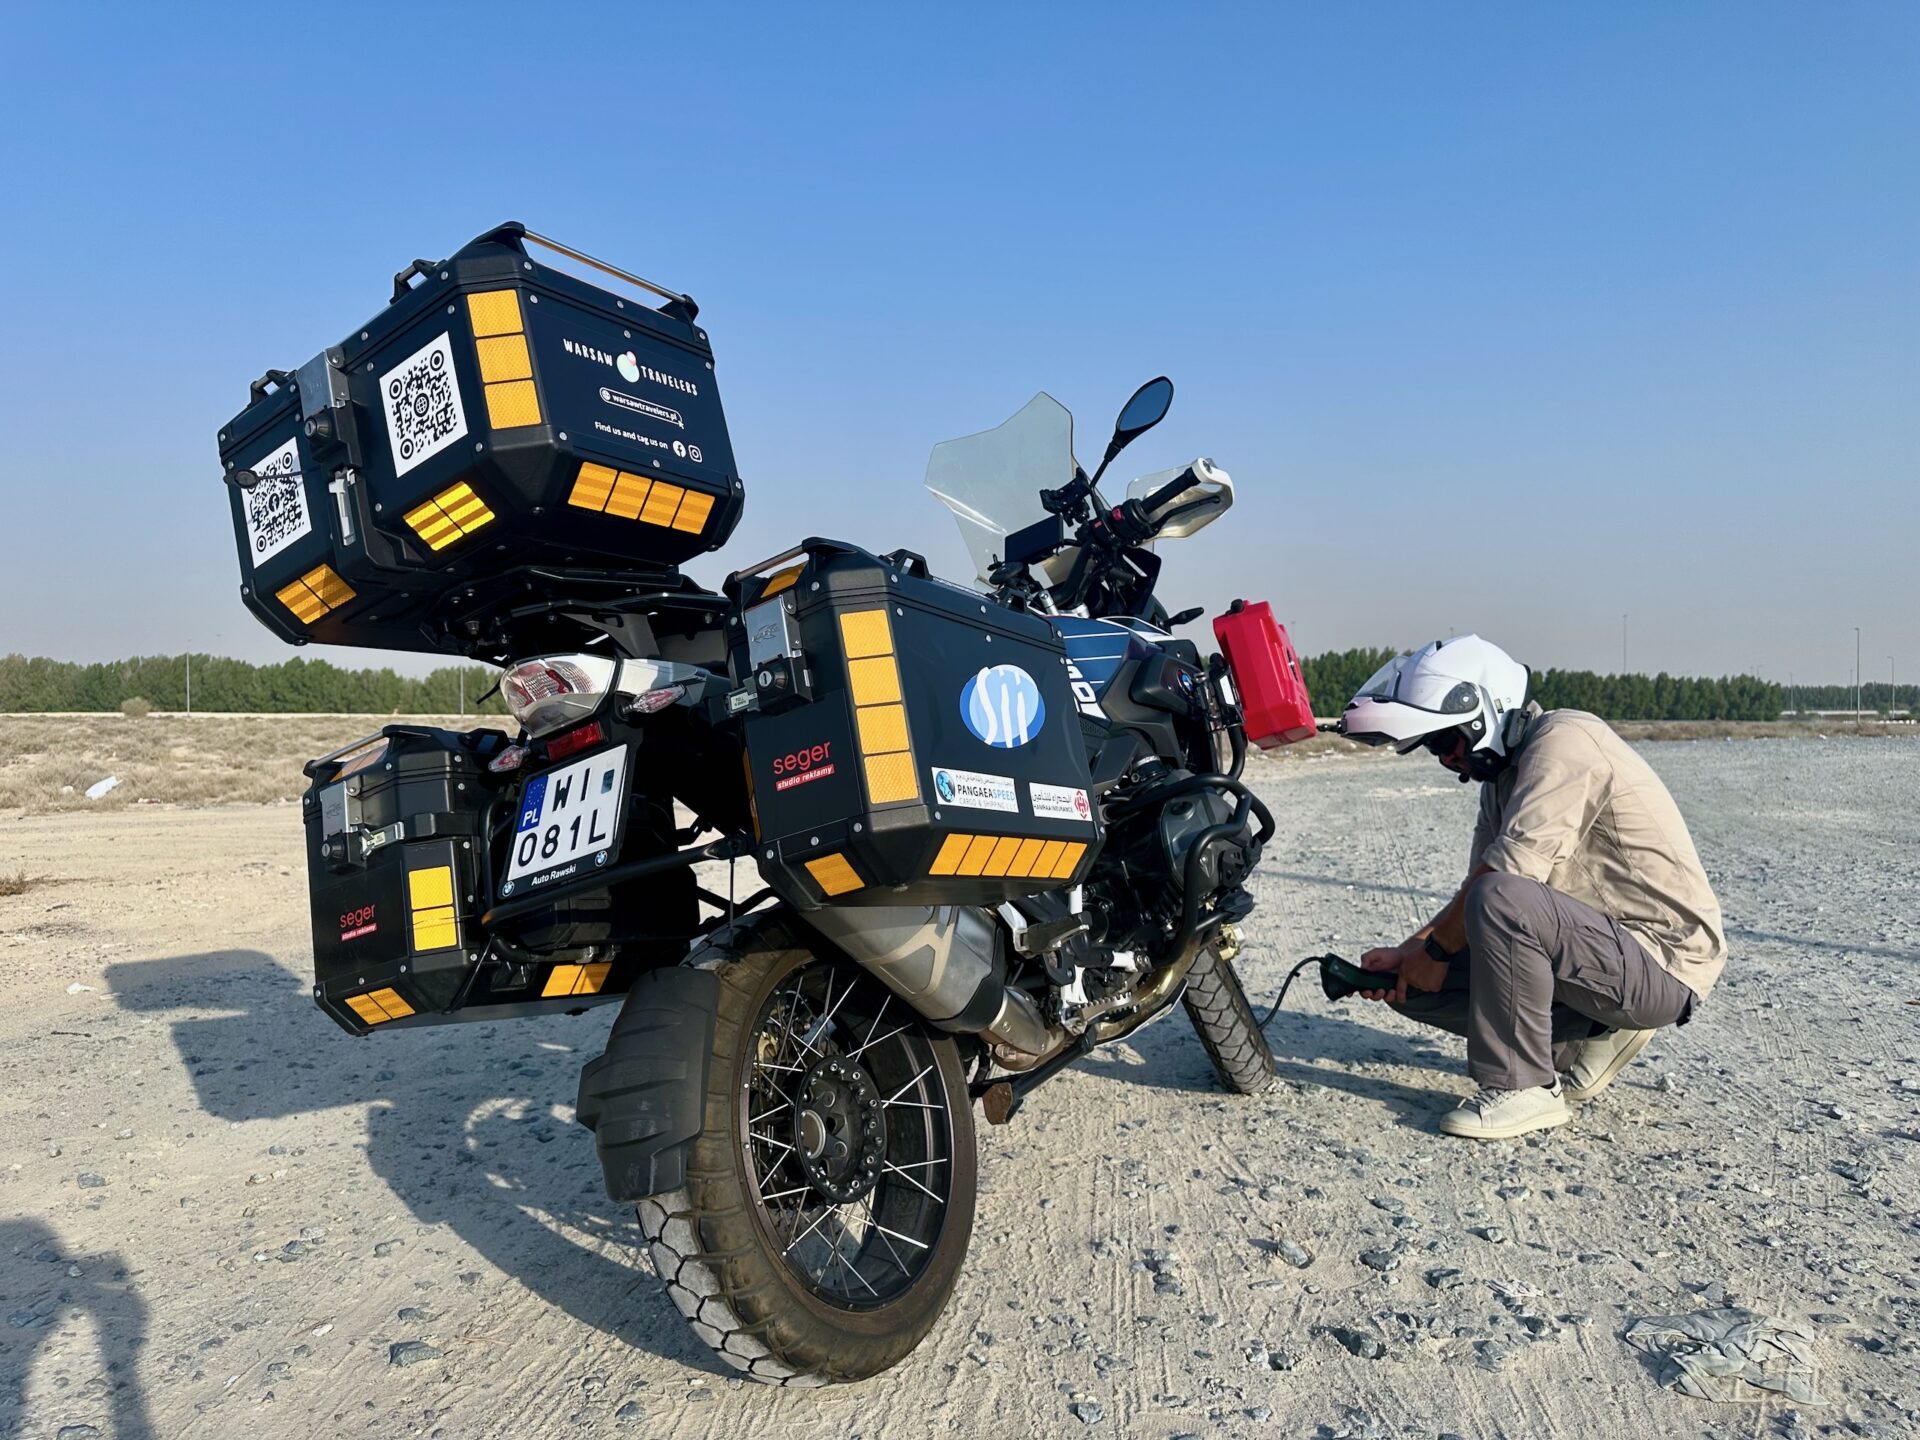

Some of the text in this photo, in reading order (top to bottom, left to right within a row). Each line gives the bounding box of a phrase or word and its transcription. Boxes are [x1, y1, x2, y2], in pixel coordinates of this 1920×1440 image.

[562, 338, 698, 396] WARSAW TRAVELERS
[612, 394, 678, 421] warsawtravelers.pl
[594, 421, 669, 450] Find us and tag us on
[772, 741, 831, 775] seger
[552, 767, 591, 812] WI
[777, 766, 833, 789] studio reklamy
[522, 808, 539, 828] PL
[518, 808, 606, 867] 081L
[531, 863, 577, 886] Auto Rawski
[340, 904, 375, 928] seger
